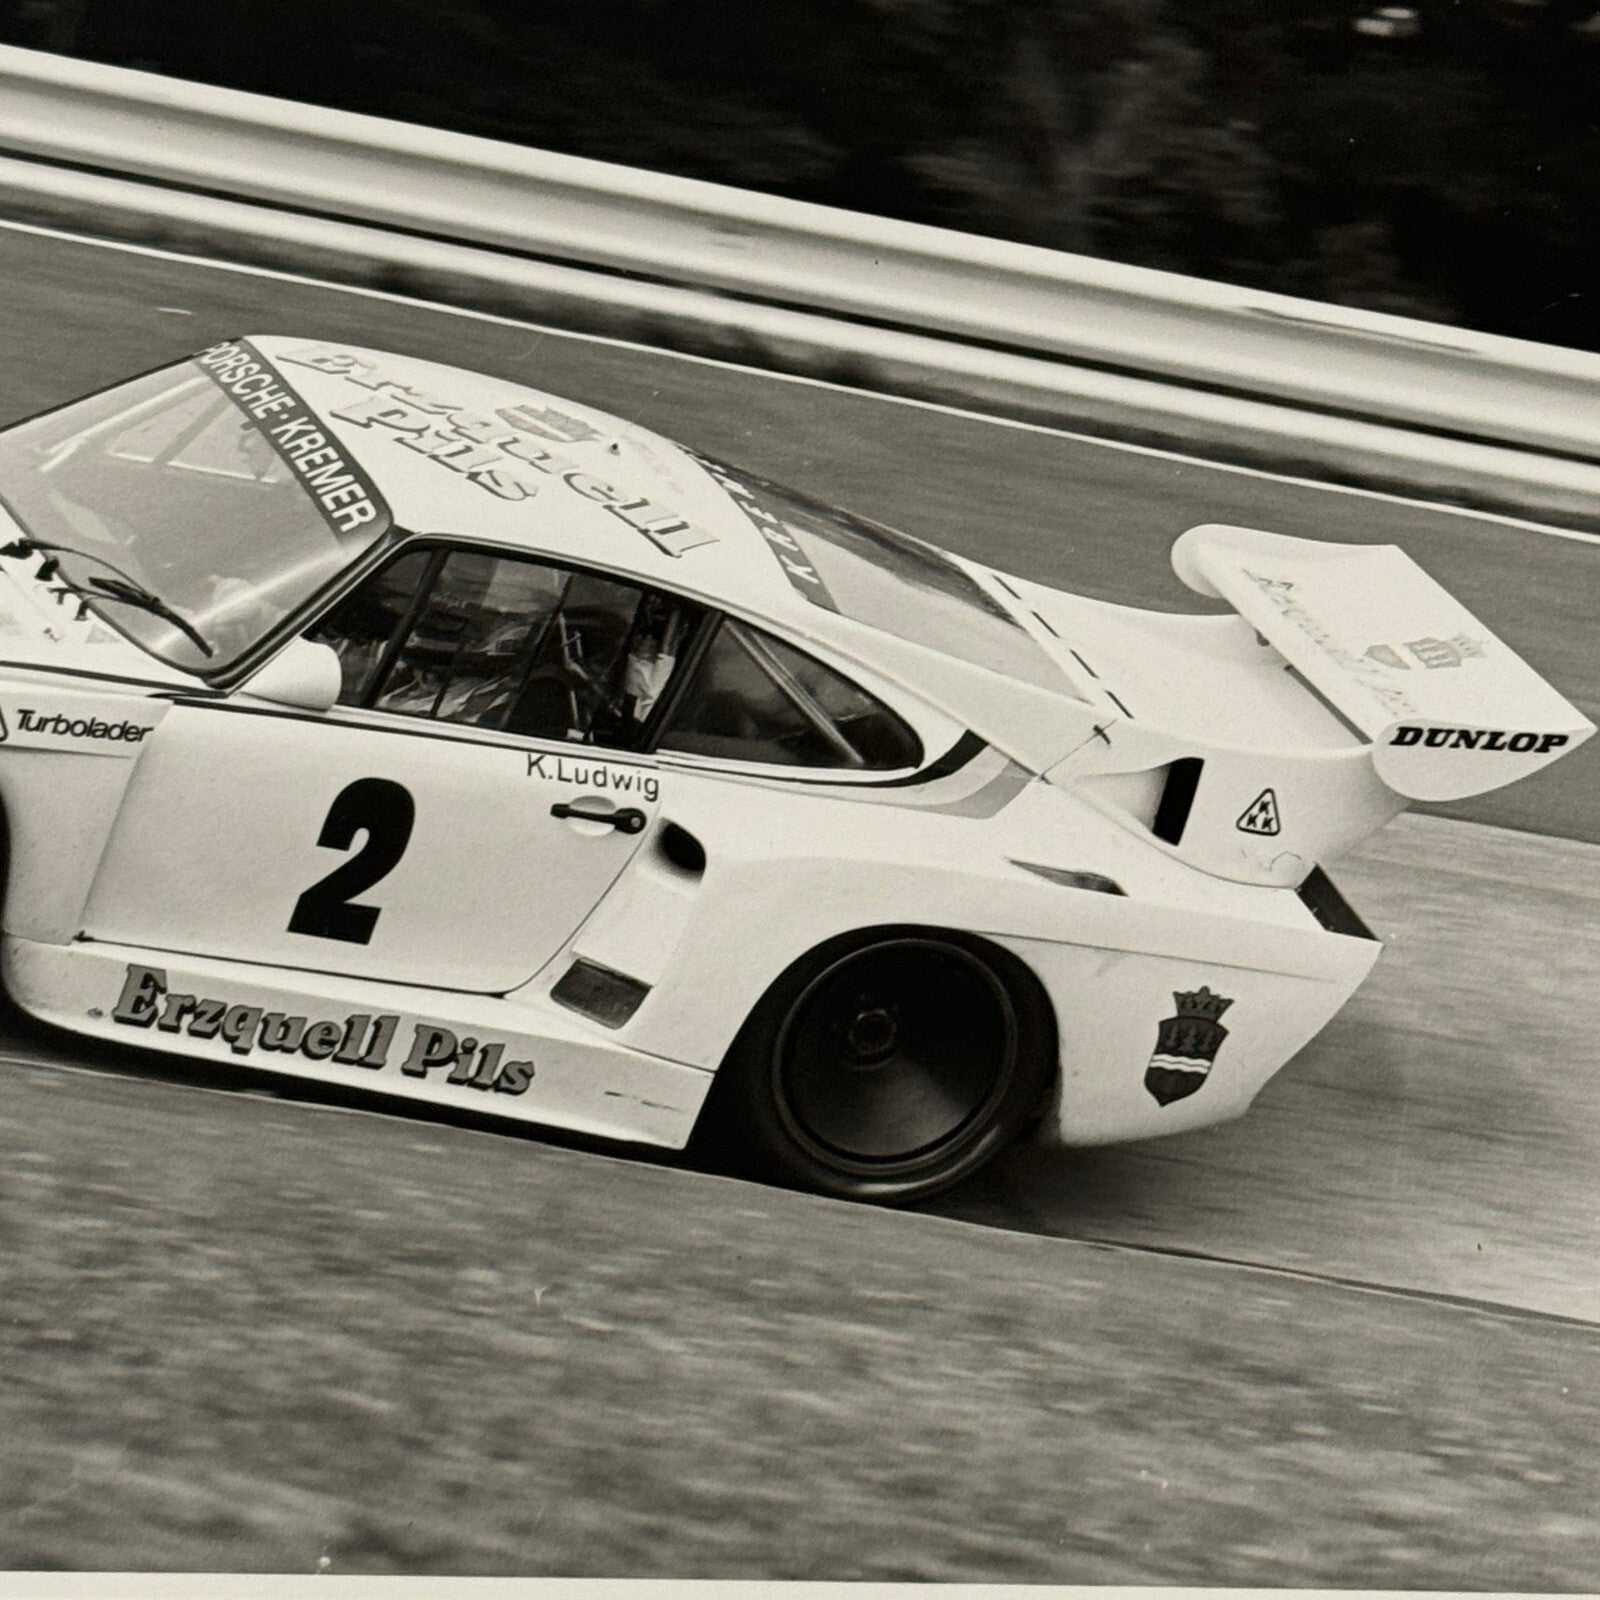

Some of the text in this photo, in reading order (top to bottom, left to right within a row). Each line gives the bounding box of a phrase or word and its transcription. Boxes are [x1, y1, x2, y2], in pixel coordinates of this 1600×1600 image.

[16, 709, 154, 743] Turbolader
[1389, 726, 1569, 754] DUNLOP
[527, 754, 660, 802] K.Ludwig
[286, 777, 416, 946] 2
[112, 963, 535, 1096] Erzquell Pils
